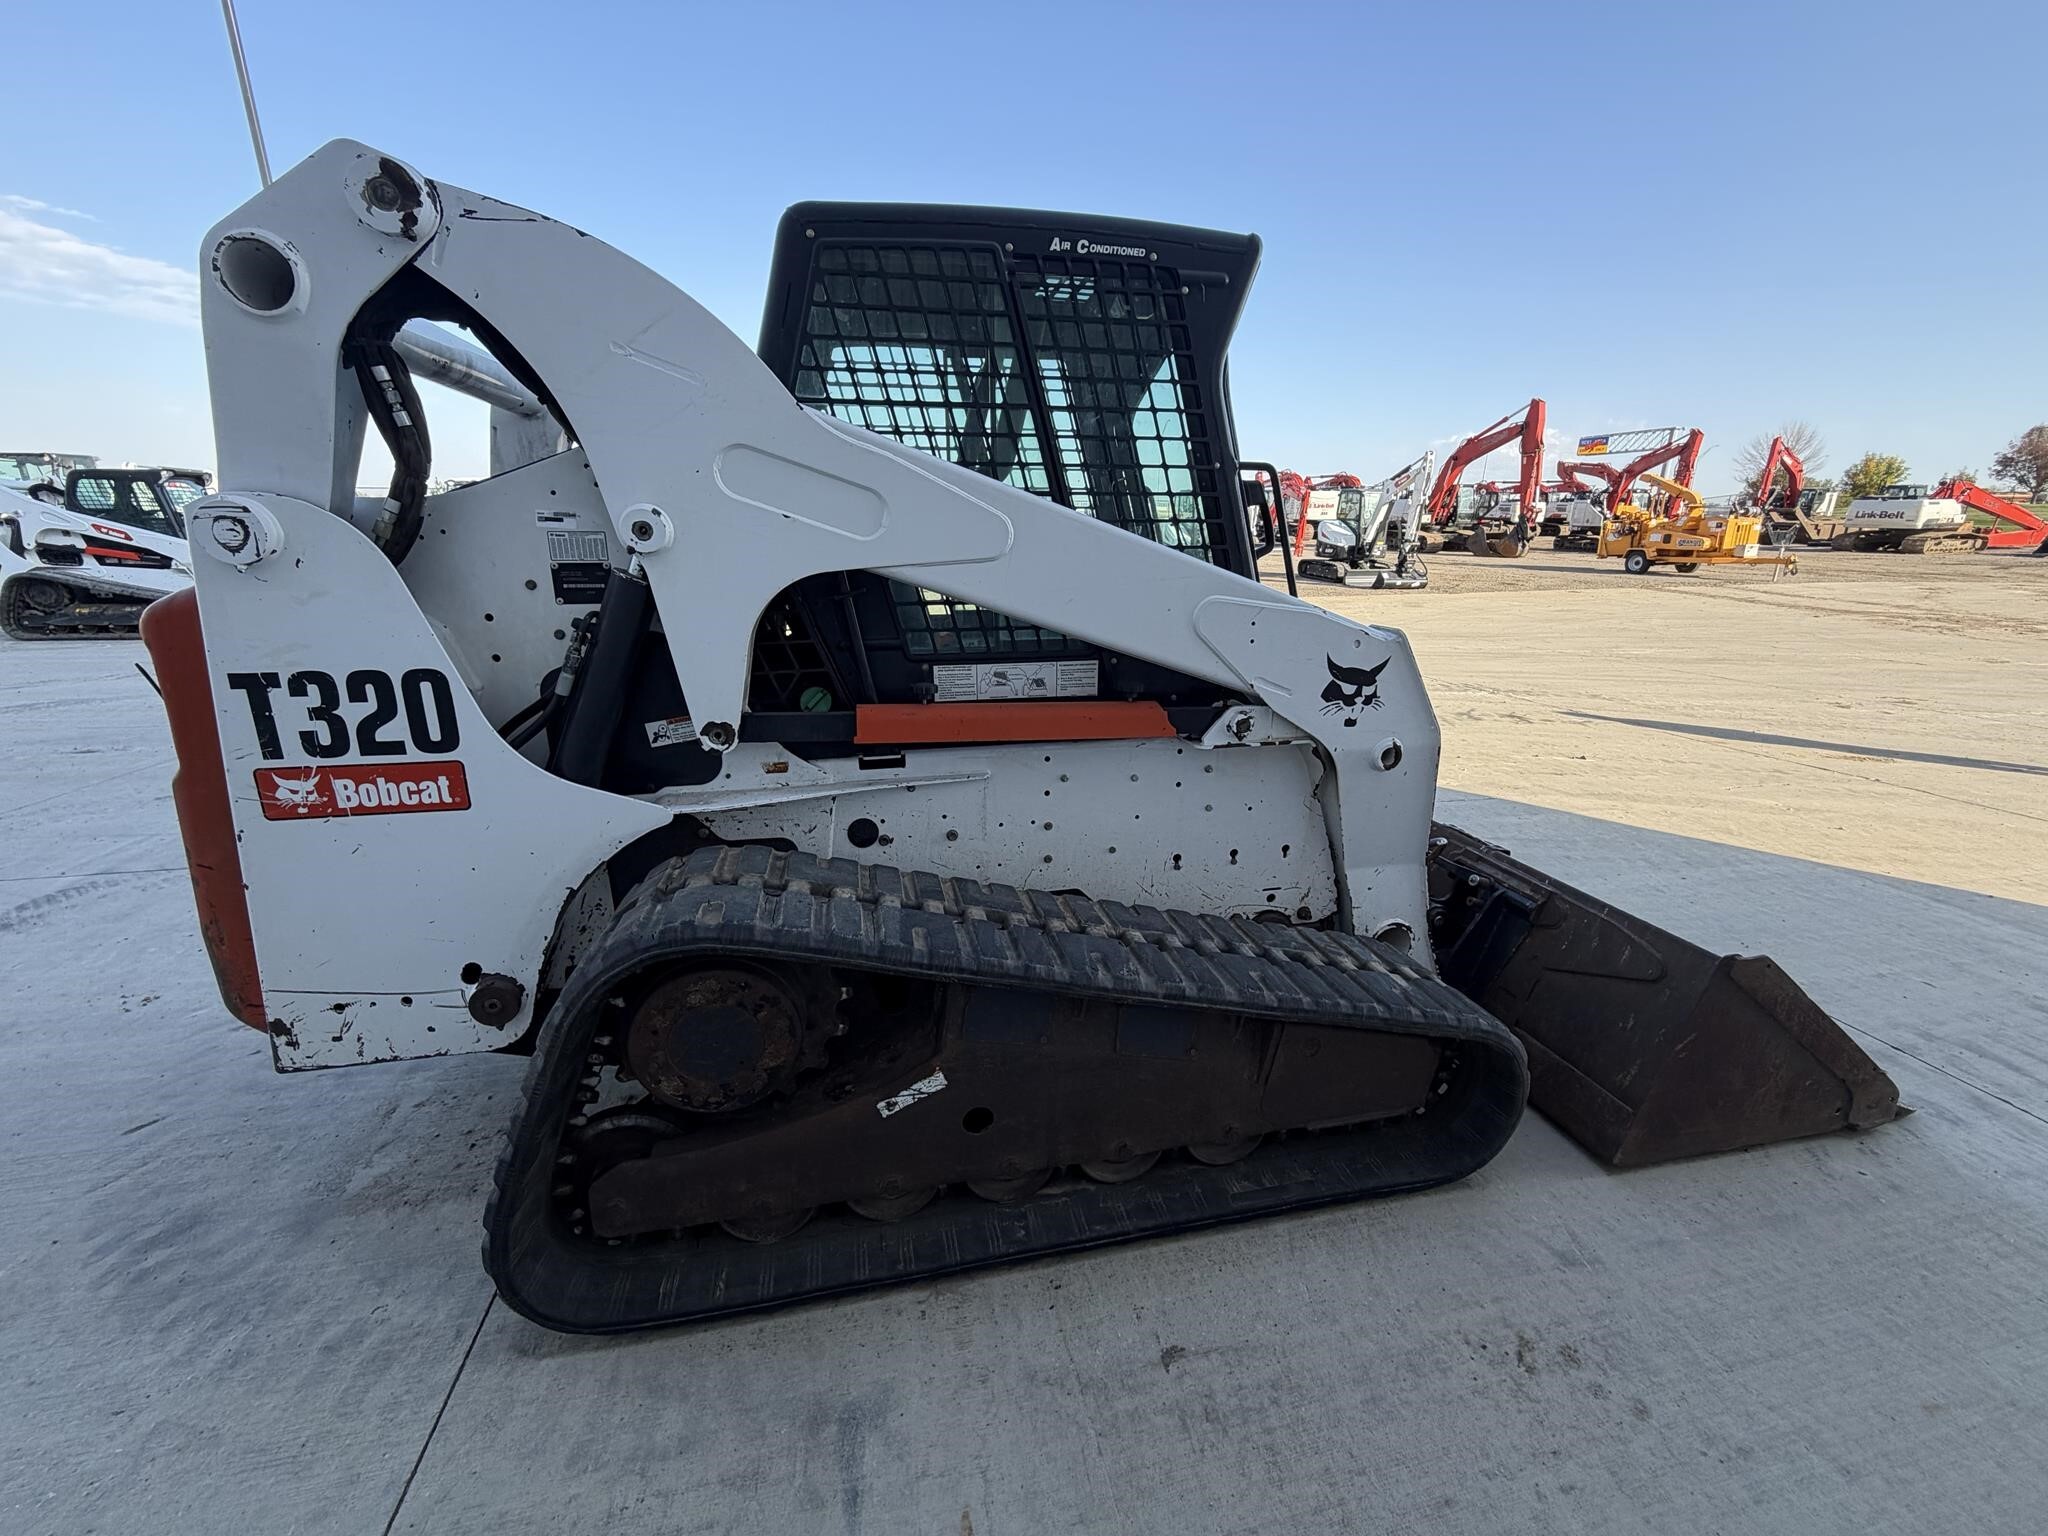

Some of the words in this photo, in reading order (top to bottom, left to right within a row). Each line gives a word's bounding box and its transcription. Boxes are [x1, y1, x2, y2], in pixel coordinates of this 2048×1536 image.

[1049, 237, 1071, 251] AIR
[1076, 239, 1146, 257] CONDITIONED
[1855, 510, 1905, 519] Link-Belt
[227, 668, 460, 760] T320
[333, 775, 453, 809] Bobcat
